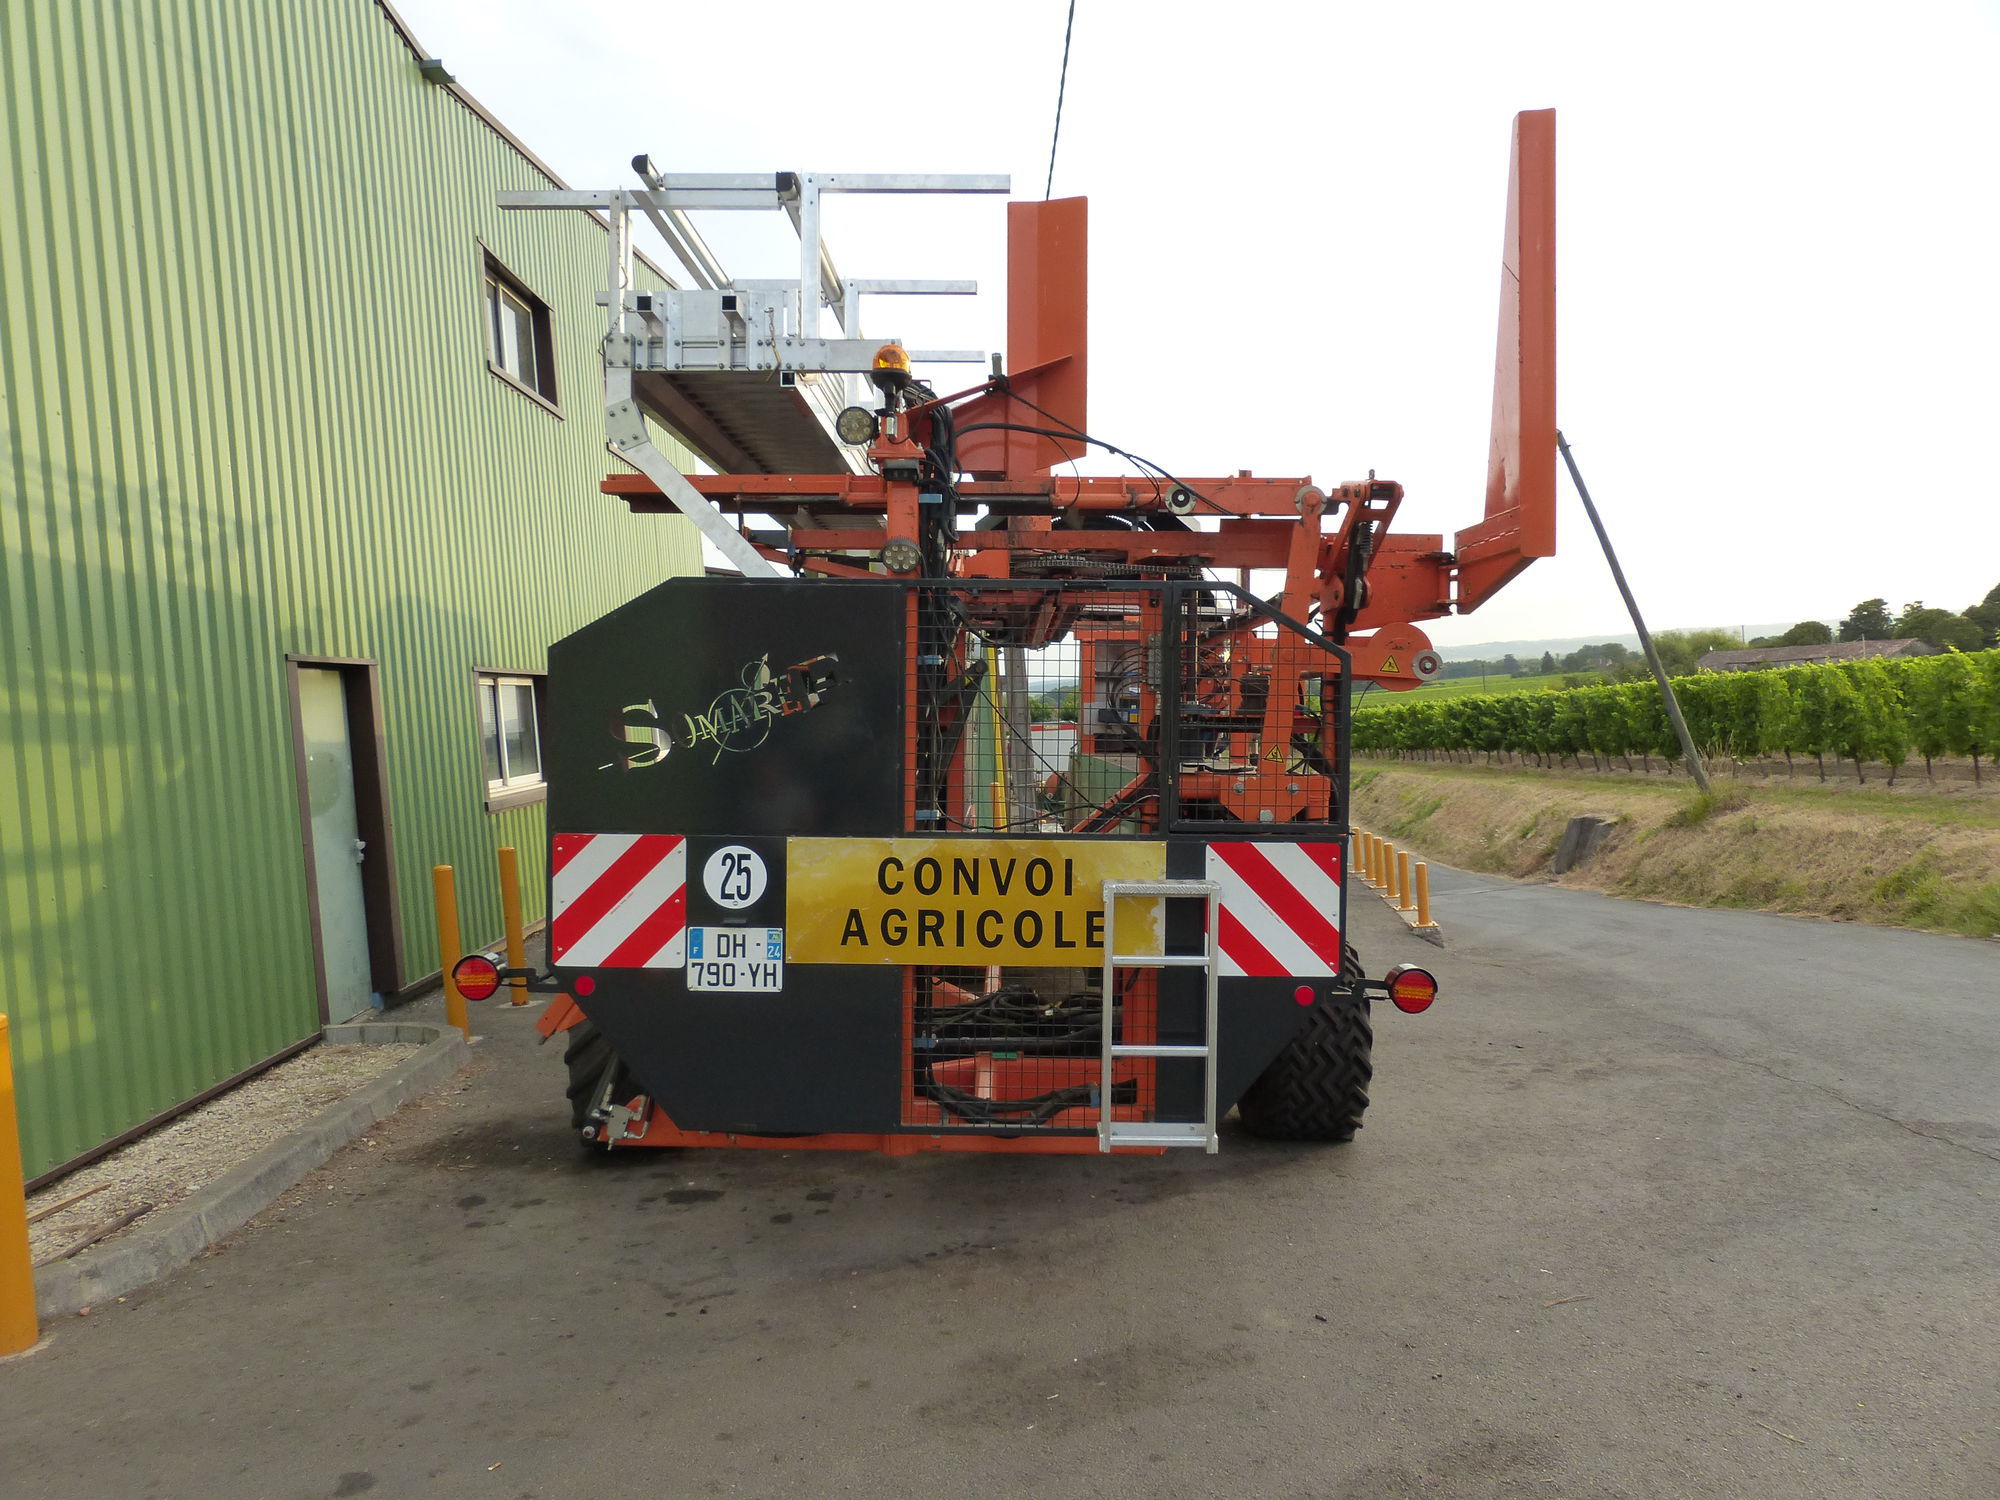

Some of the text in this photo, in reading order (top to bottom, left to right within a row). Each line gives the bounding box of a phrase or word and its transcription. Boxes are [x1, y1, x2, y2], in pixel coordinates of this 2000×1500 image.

[720, 852, 752, 901] 25
[877, 856, 1073, 897] CONVOI
[840, 908, 1105, 949] AGRICOLE
[693, 946, 699, 955] F
[767, 945, 781, 957] 24
[691, 962, 777, 987] 790-YH
